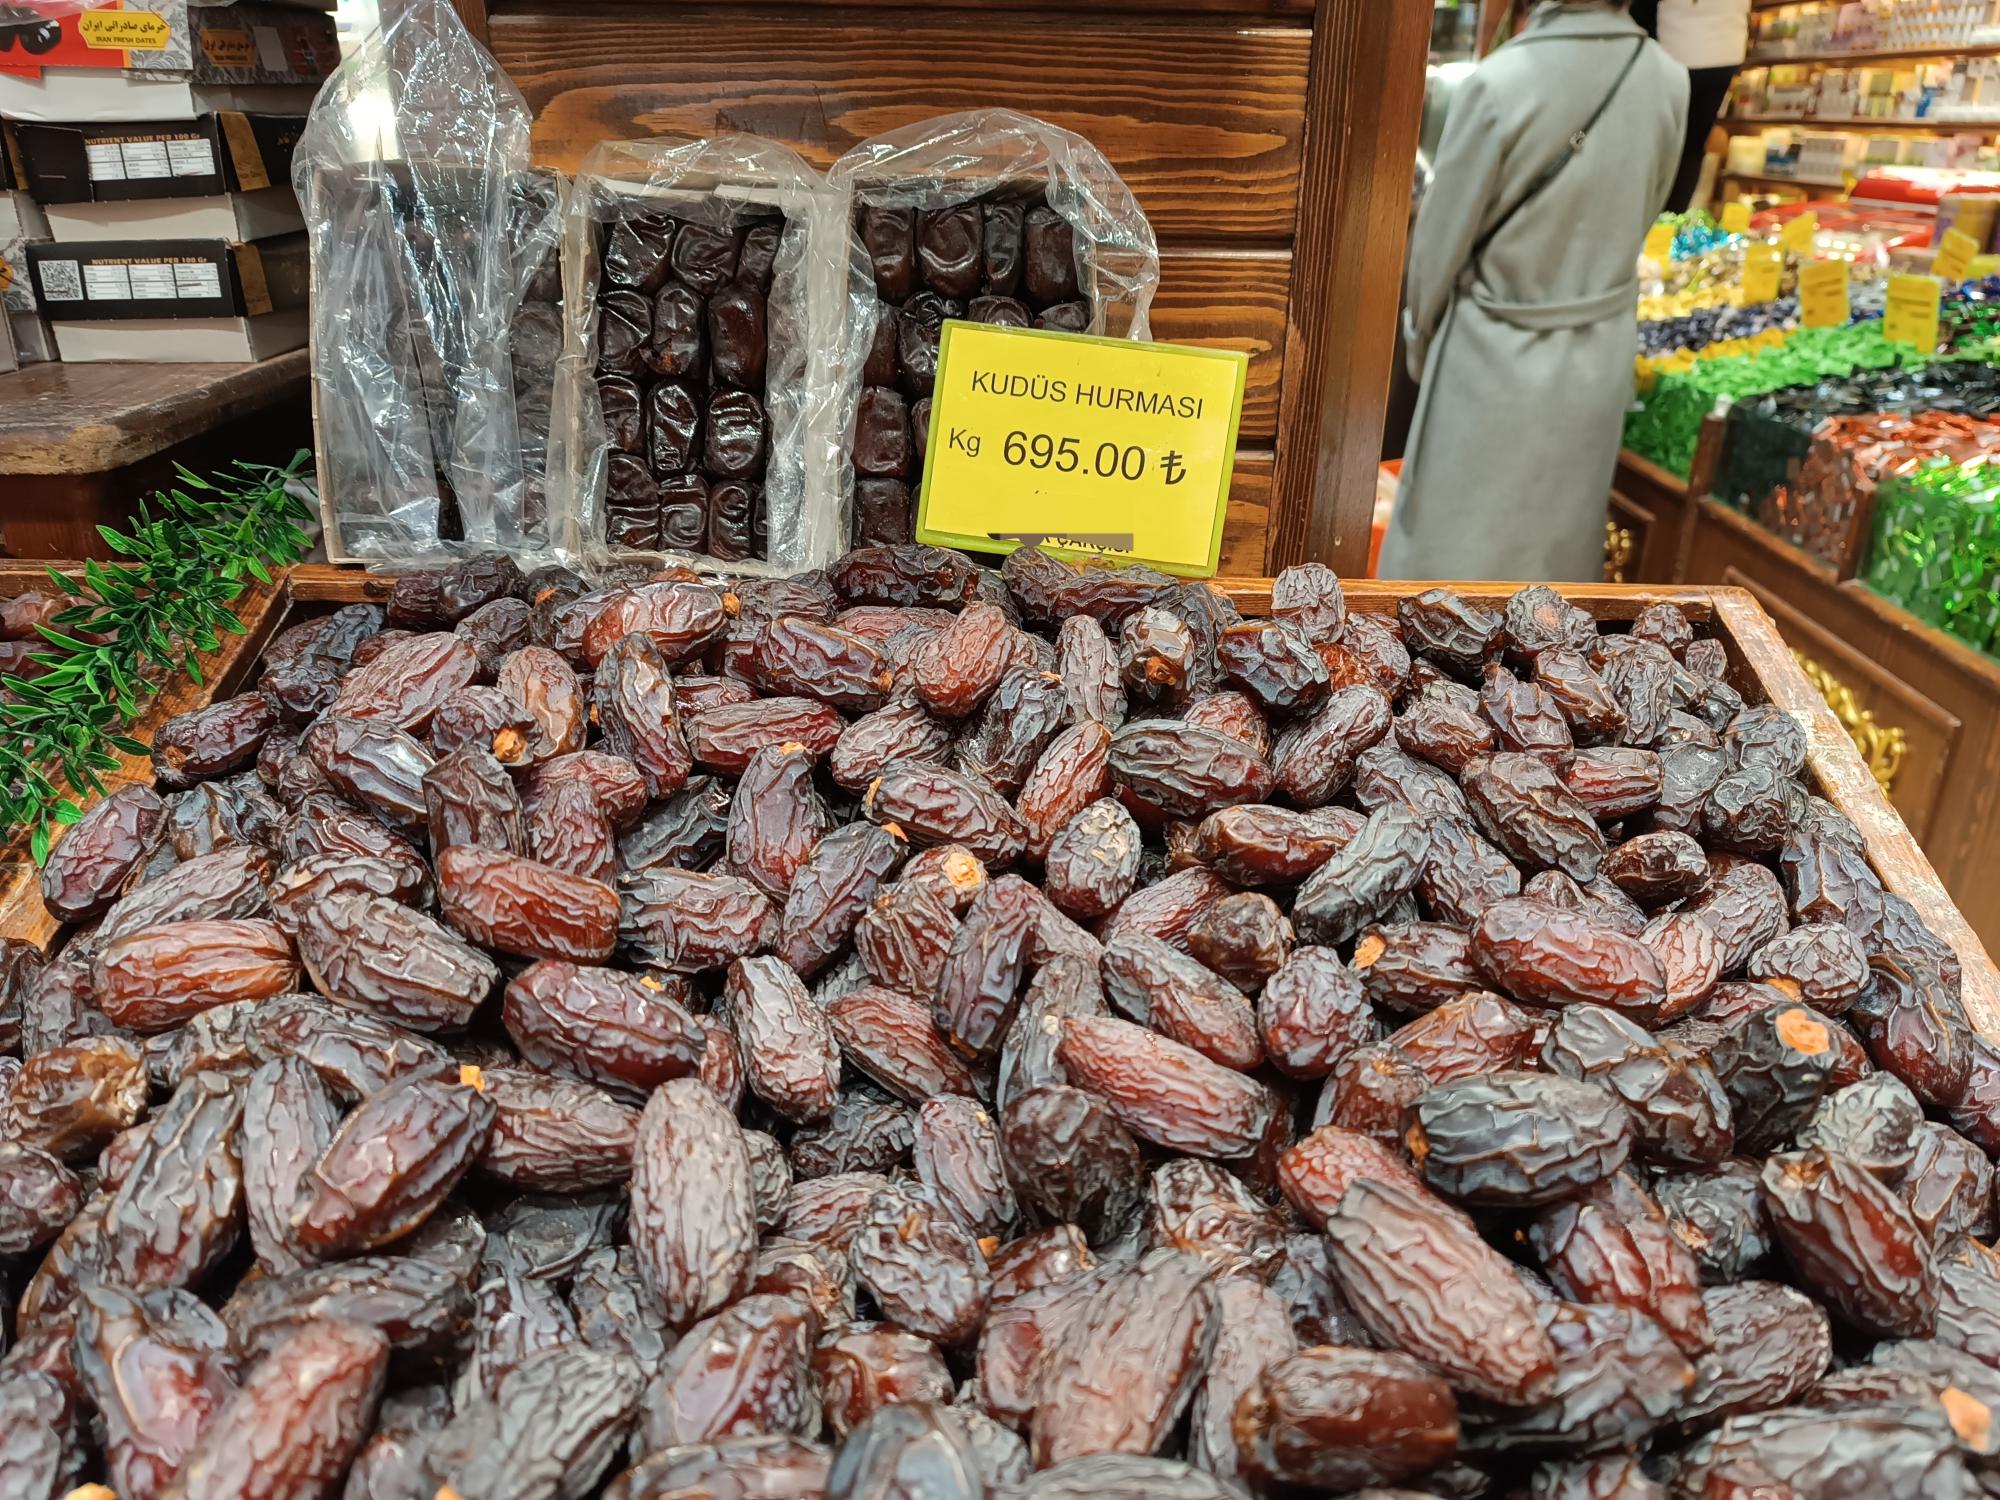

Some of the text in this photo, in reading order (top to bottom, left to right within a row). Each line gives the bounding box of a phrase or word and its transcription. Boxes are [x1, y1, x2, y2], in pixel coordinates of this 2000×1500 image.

[84, 136, 124, 145] NUTRIENT
[126, 135, 153, 143] VALUE
[971, 370, 1204, 420] KUDÜS HURMASI
[948, 428, 982, 458] Kg
[1003, 430, 1146, 481] 695.00
